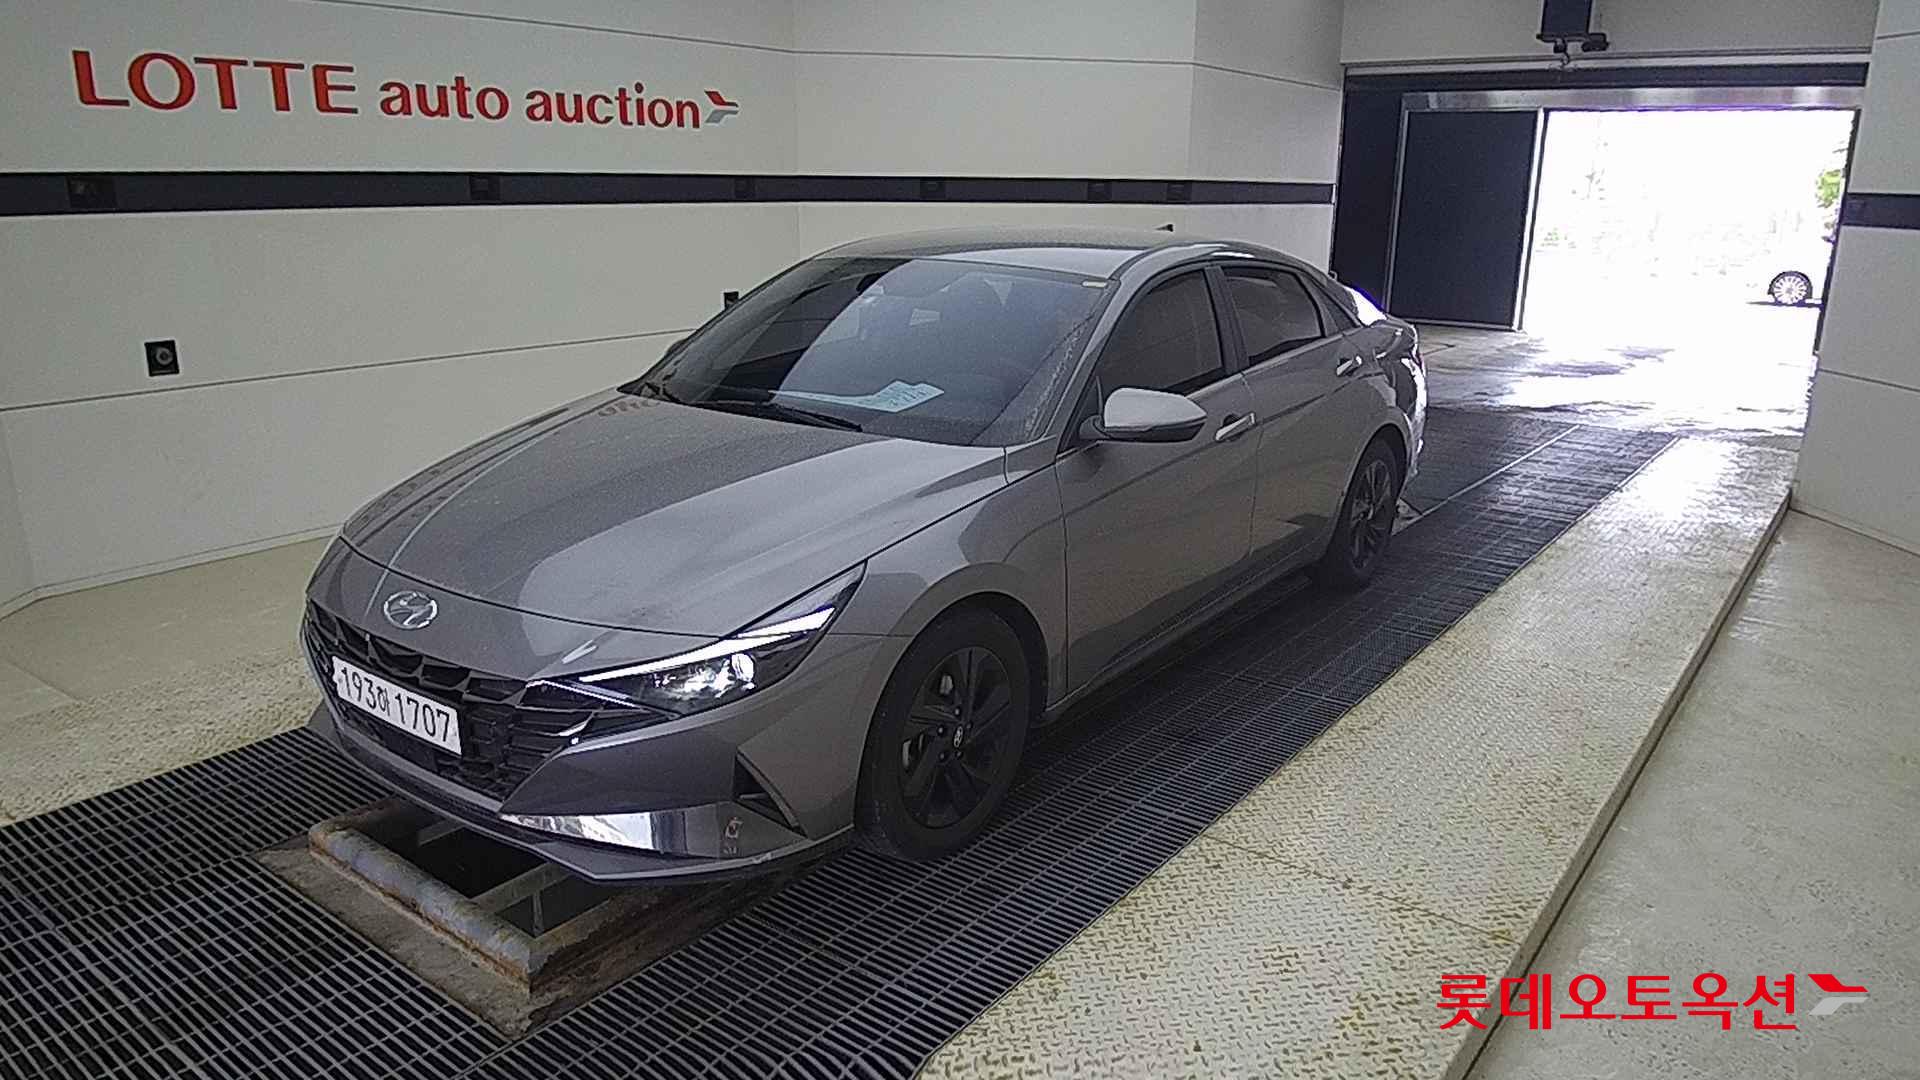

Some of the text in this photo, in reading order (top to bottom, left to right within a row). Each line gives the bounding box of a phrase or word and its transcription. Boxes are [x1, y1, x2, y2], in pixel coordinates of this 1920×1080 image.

[72, 50, 701, 128] LOTTE auto auction
[395, 692, 450, 742] 1707
